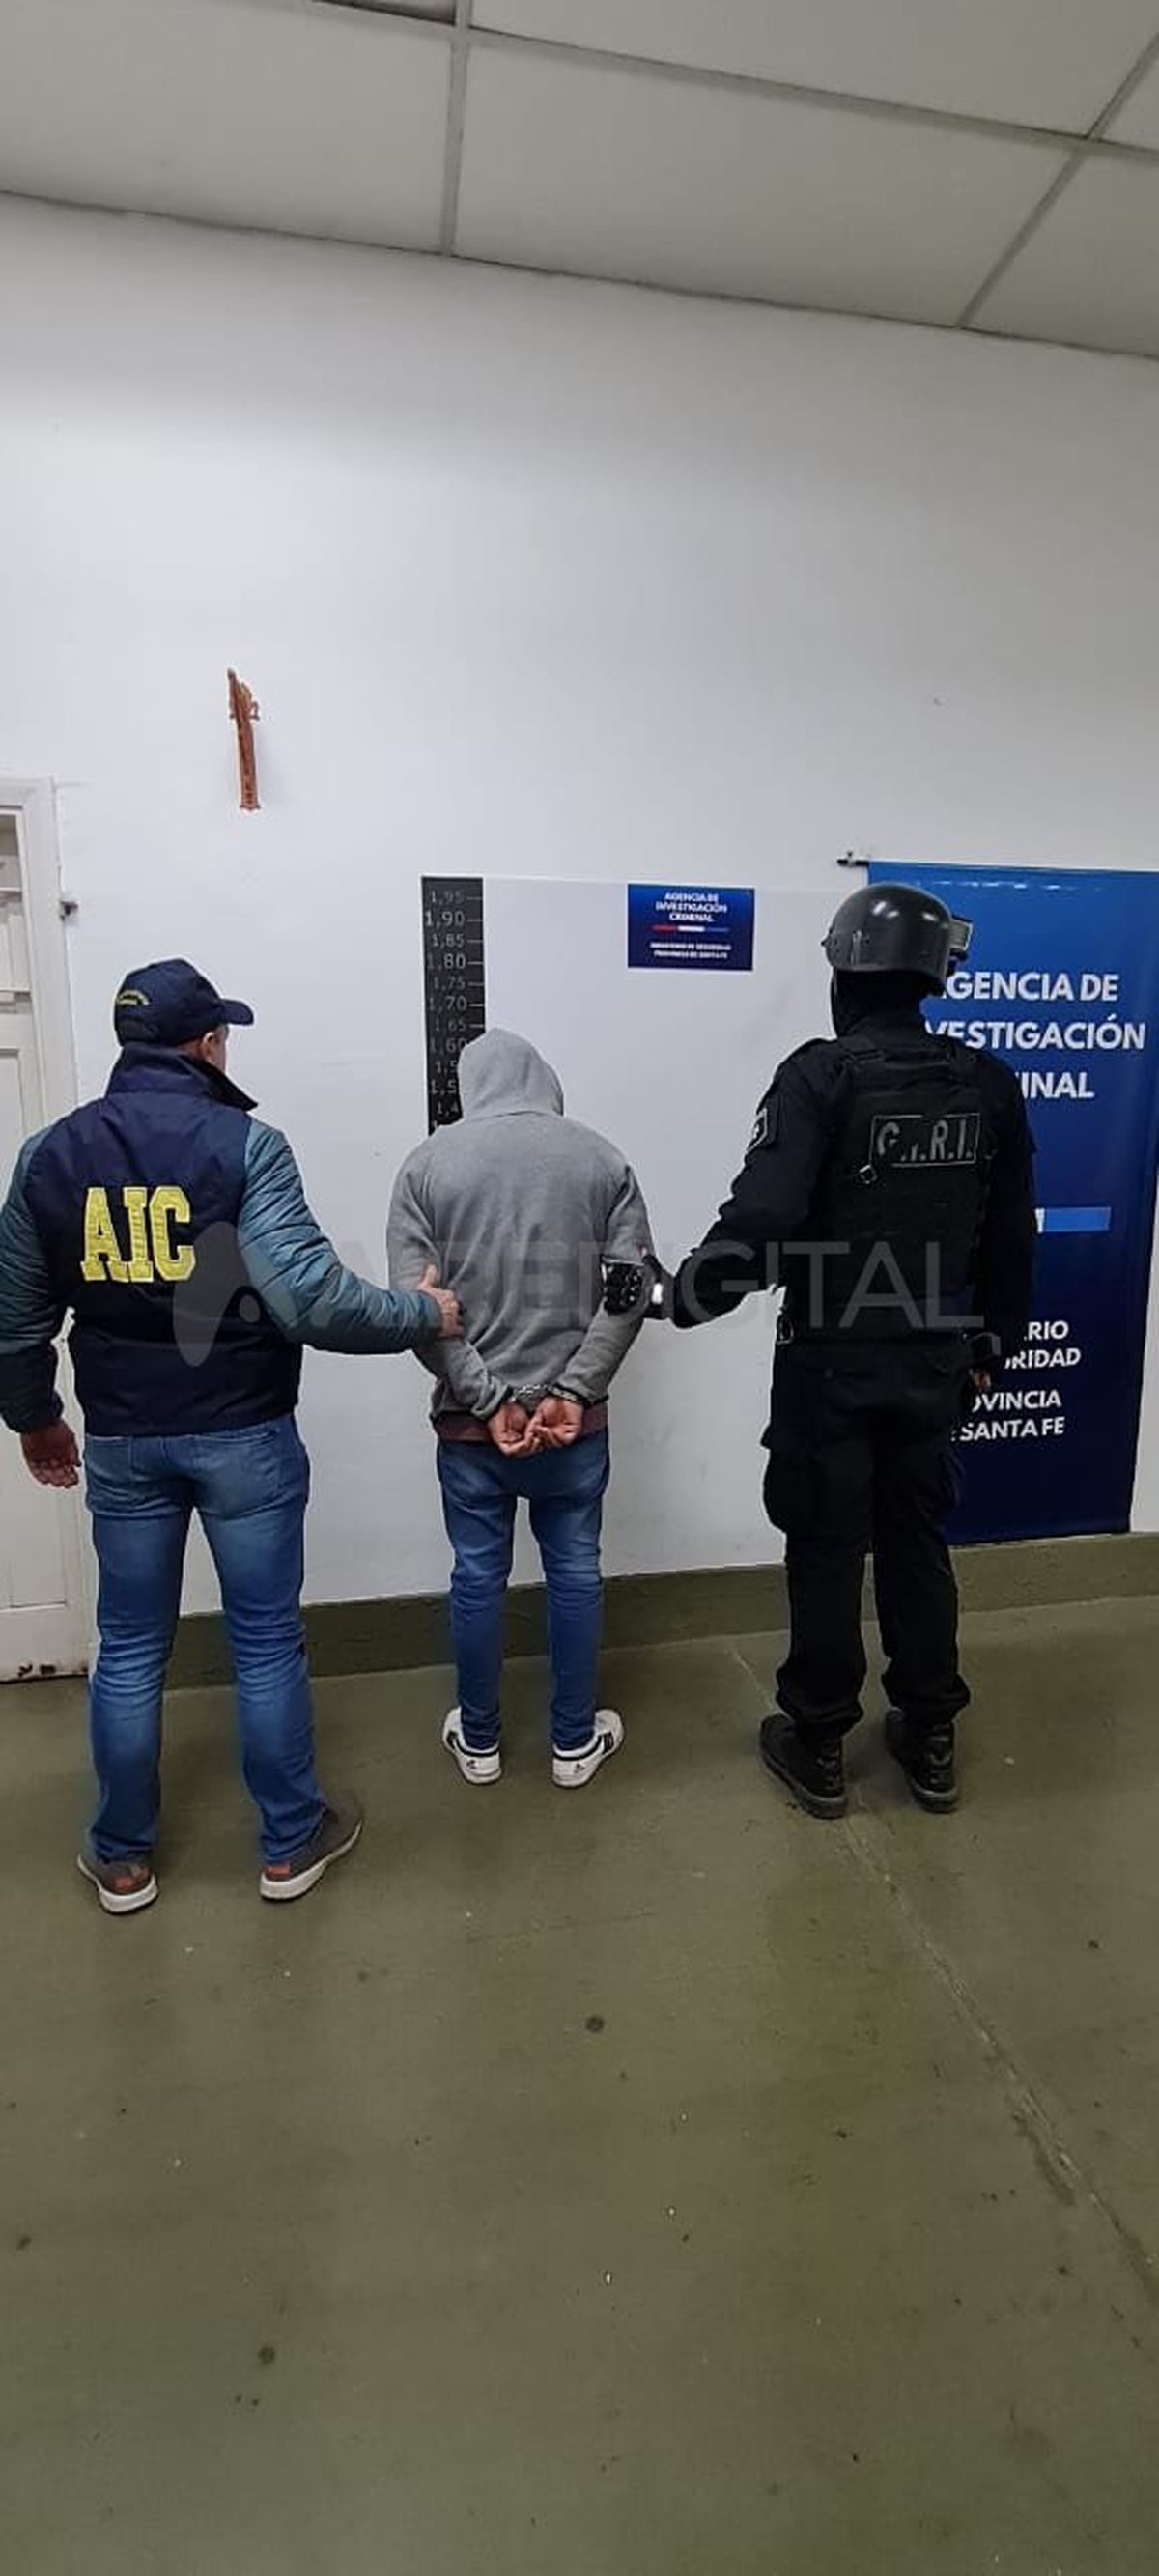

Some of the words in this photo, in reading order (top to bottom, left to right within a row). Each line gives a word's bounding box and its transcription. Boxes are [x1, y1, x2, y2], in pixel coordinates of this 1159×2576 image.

[431, 891, 465, 905] 1,95
[425, 910, 465, 928] 1,90
[432, 933, 465, 948] 1,85
[427, 953, 466, 970] 1,80
[434, 977, 466, 991] 1,75
[943, 971, 1075, 1001] GENCIA
[1080, 974, 1119, 1002] DE
[429, 996, 467, 1013] 1,70
[435, 1018, 466, 1033] 1,65
[924, 1013, 1146, 1050] VESTIGACIÓN
[436, 1060, 458, 1077] 1,5
[432, 1079, 458, 1095] 1,5
[1016, 1071, 1095, 1099] INAL
[437, 1102, 461, 1117] 1,4
[80, 1186, 196, 1284] AIC
[1024, 1320, 1069, 1341] RIO
[1004, 1347, 1082, 1369] RIDAD
[959, 1419, 1038, 1442] SANTA
[1041, 1416, 1065, 1436] FE
